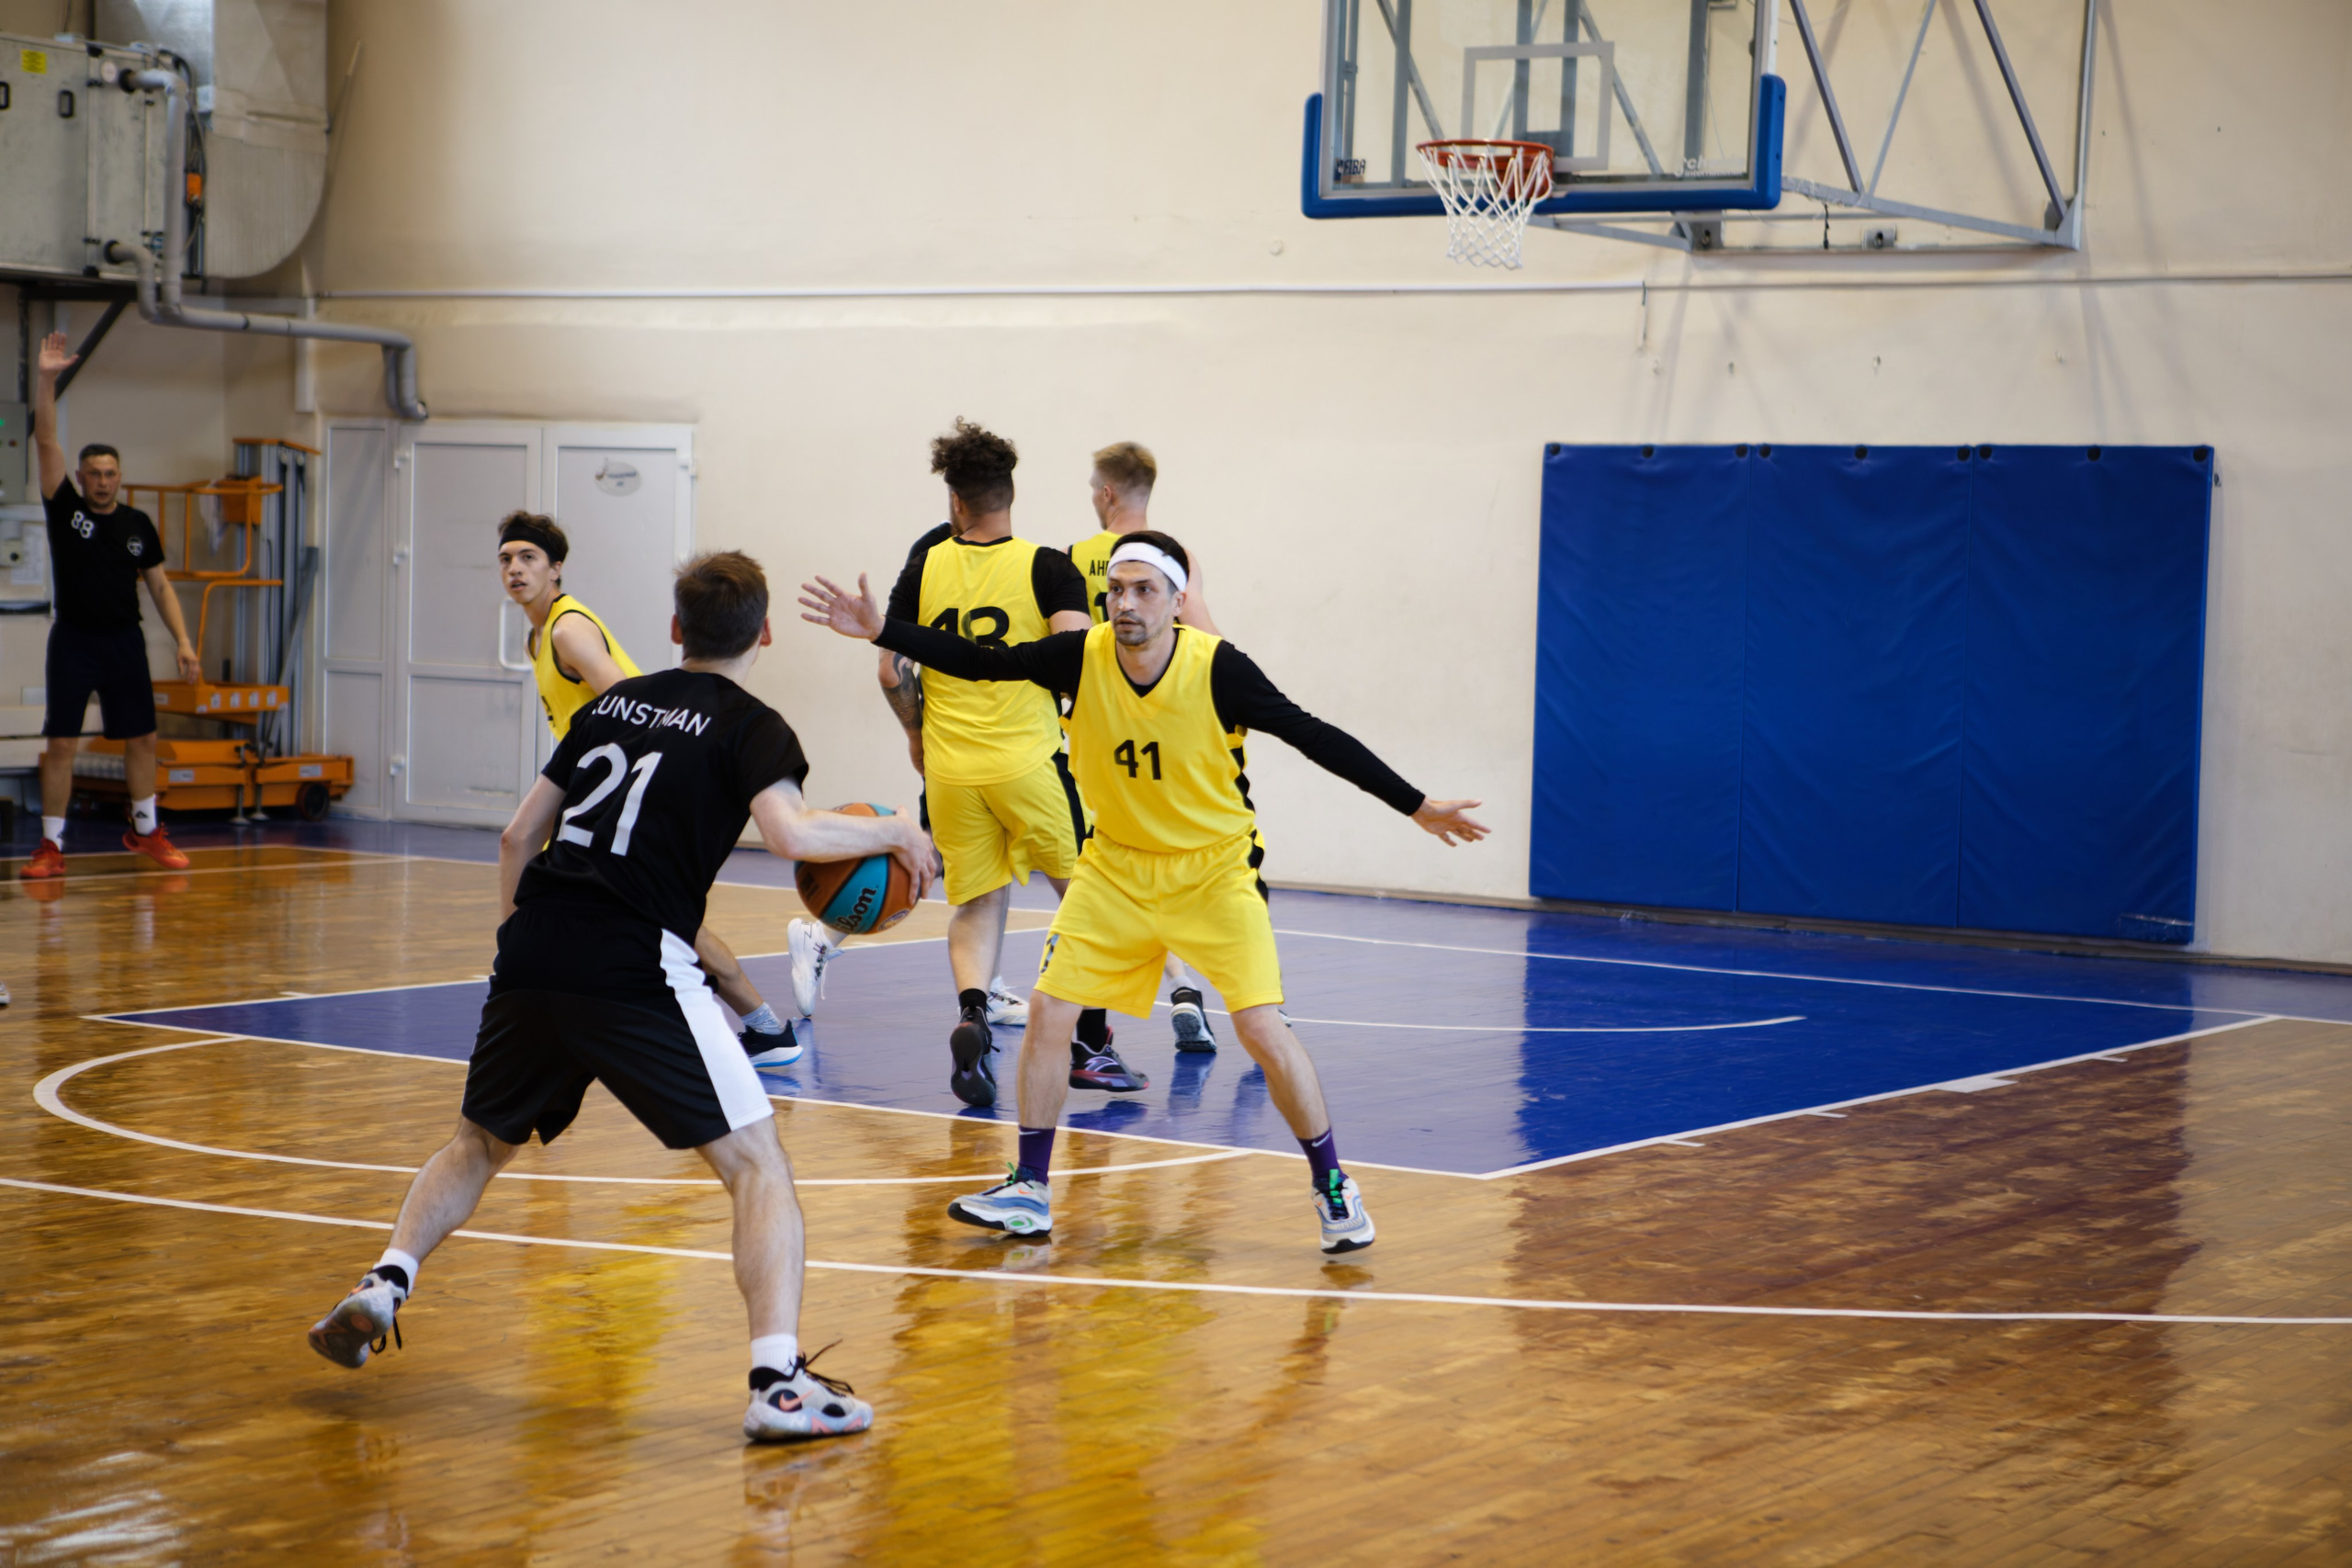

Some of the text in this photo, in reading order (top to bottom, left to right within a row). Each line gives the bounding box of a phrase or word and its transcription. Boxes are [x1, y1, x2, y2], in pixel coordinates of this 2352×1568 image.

[71, 511, 94, 538] 88
[592, 695, 712, 737] UNSTMAN
[1114, 739, 1161, 781] 41
[556, 742, 662, 856] 21
[831, 886, 877, 933] ilson
